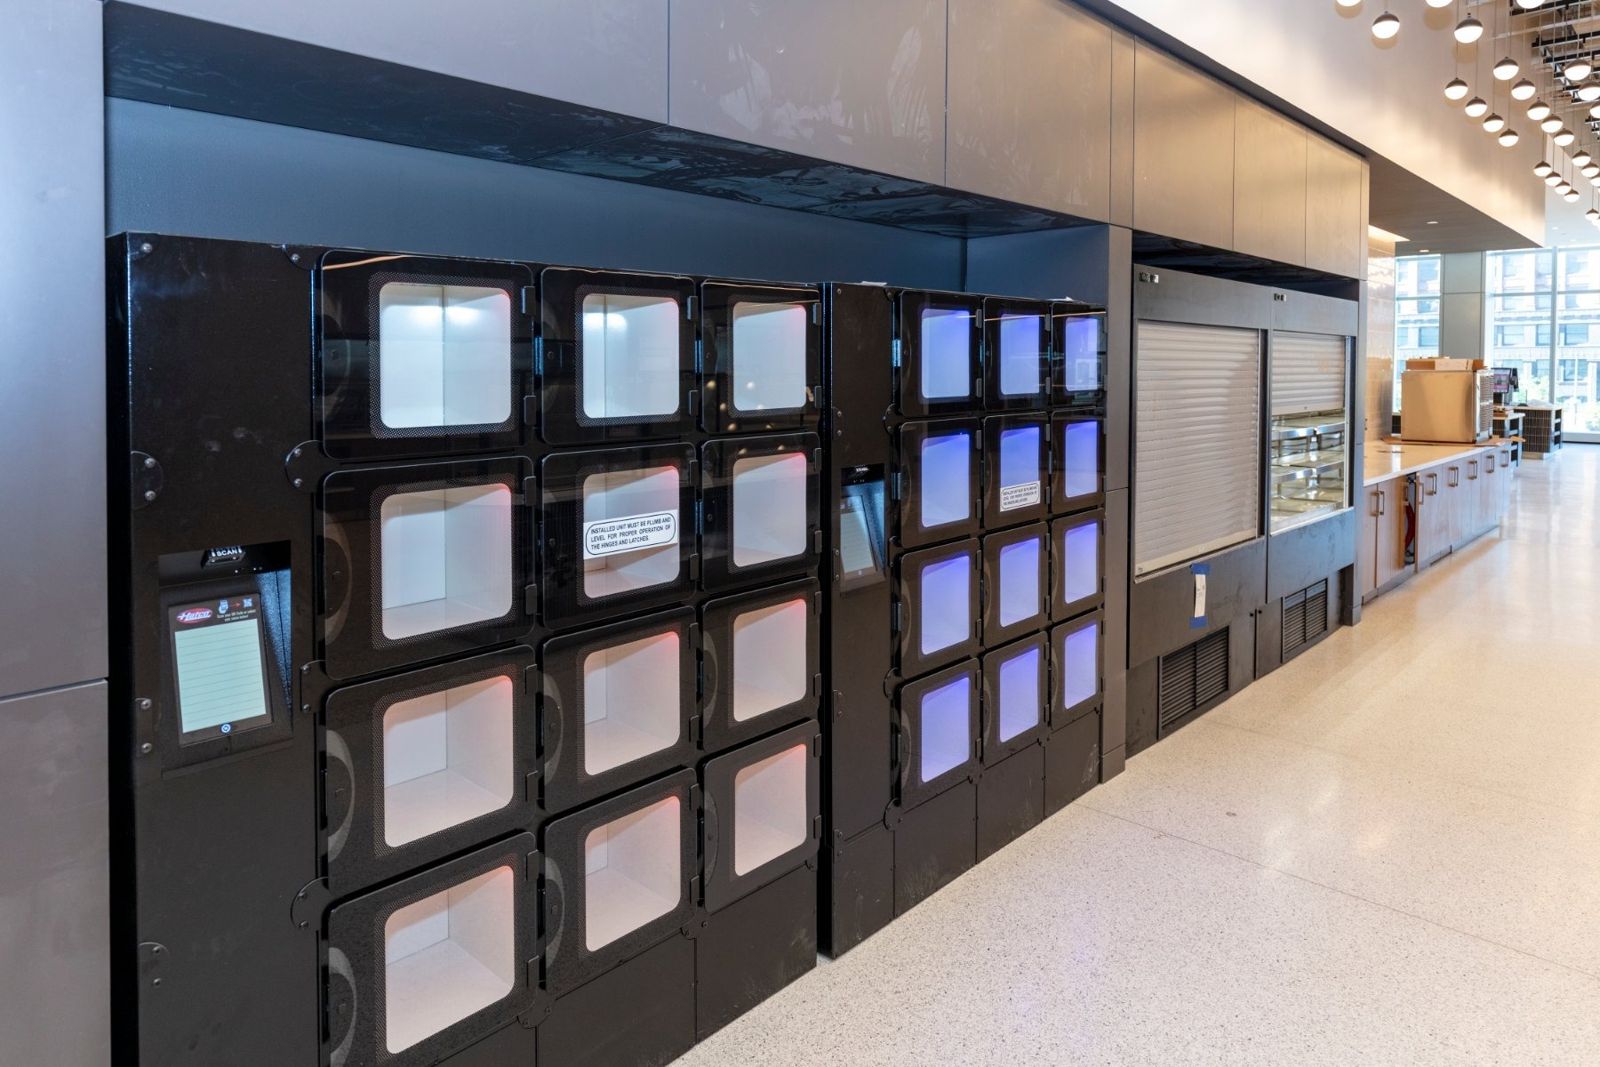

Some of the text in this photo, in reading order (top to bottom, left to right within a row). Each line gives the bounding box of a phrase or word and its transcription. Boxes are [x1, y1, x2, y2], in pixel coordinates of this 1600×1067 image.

[590, 526, 616, 534] INSTALLED
[620, 529, 638, 538] PROPER
[638, 526, 664, 534] OPERATION
[601, 540, 618, 548] HINGES
